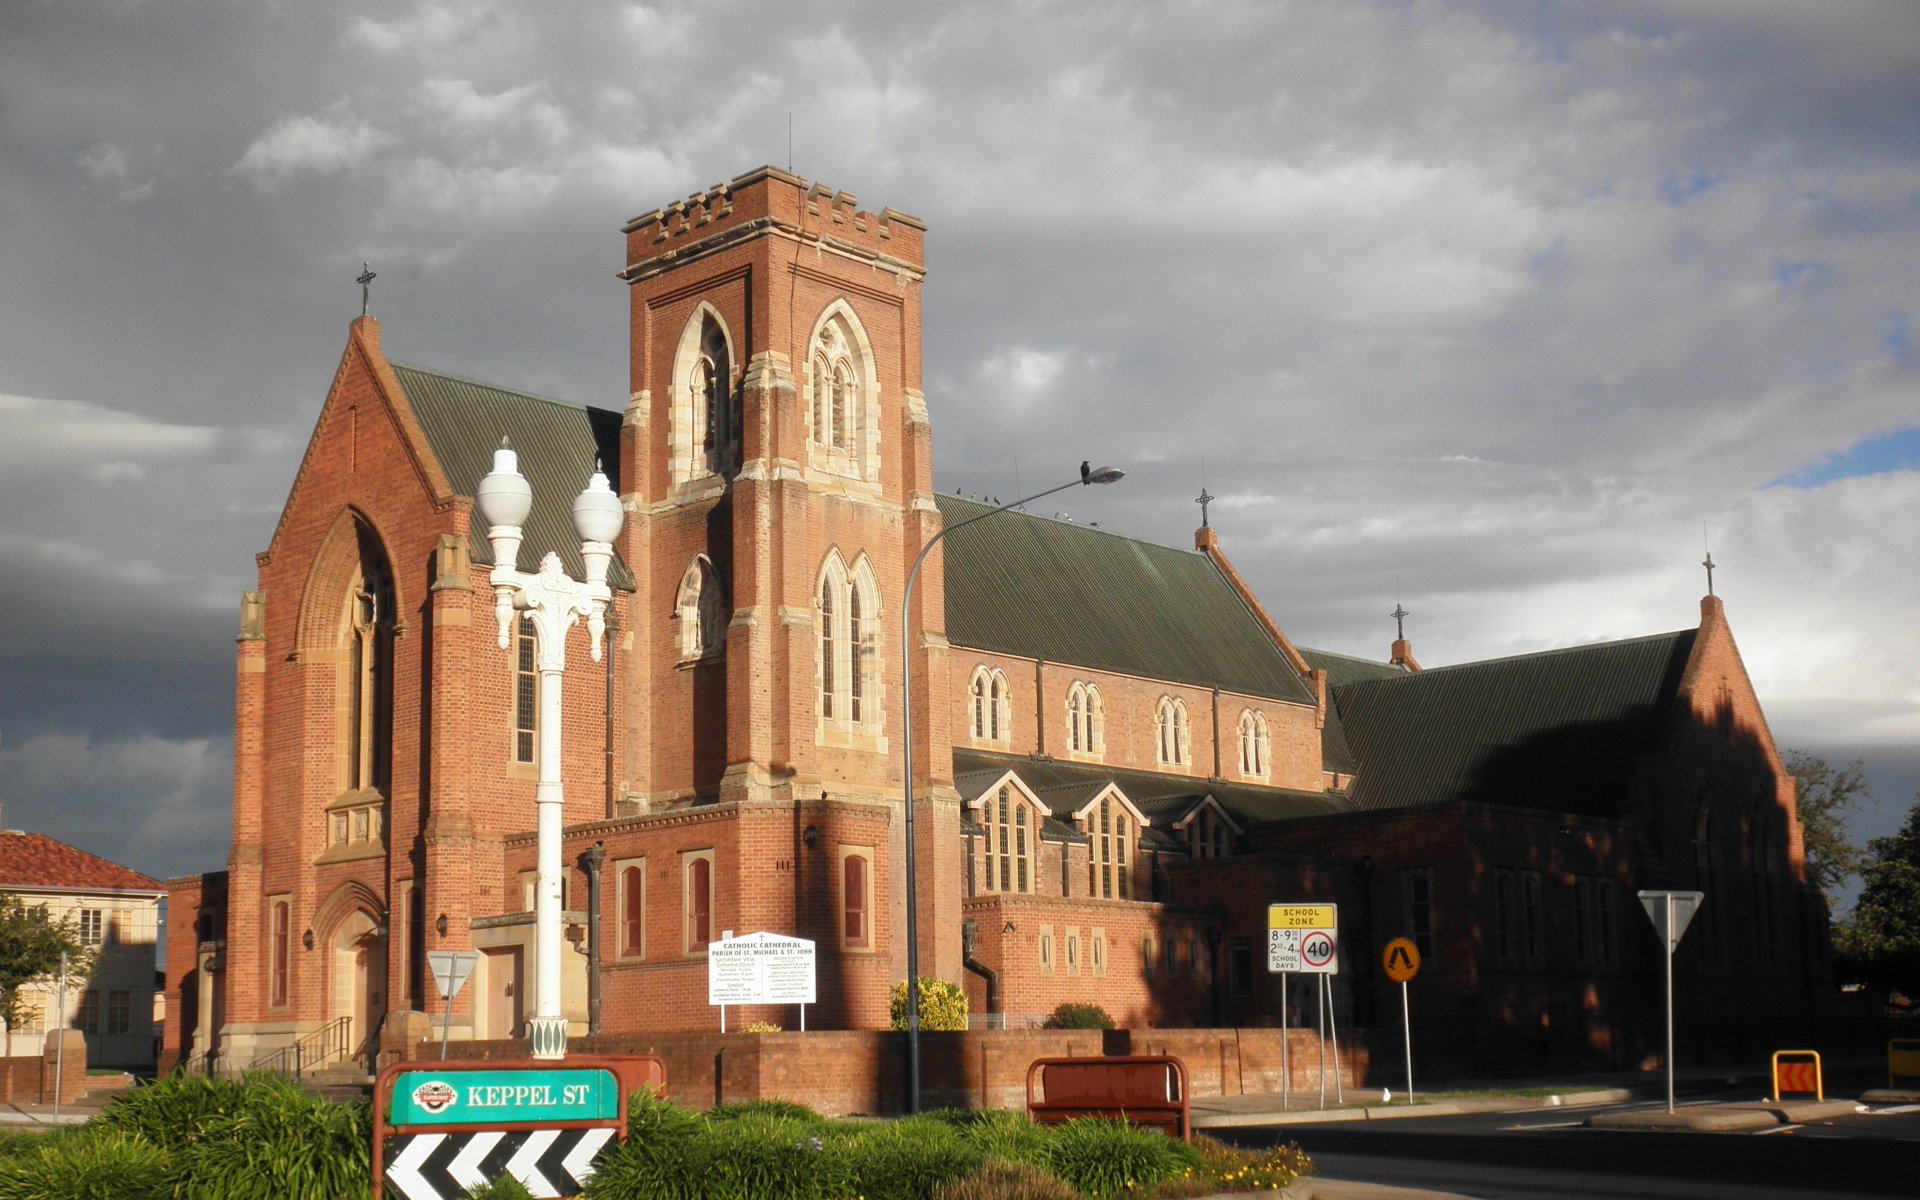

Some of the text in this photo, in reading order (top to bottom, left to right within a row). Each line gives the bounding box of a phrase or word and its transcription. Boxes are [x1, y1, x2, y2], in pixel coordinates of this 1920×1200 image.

[1307, 941, 1329, 957] 40
[466, 1085, 590, 1107] KEPPEL ST
